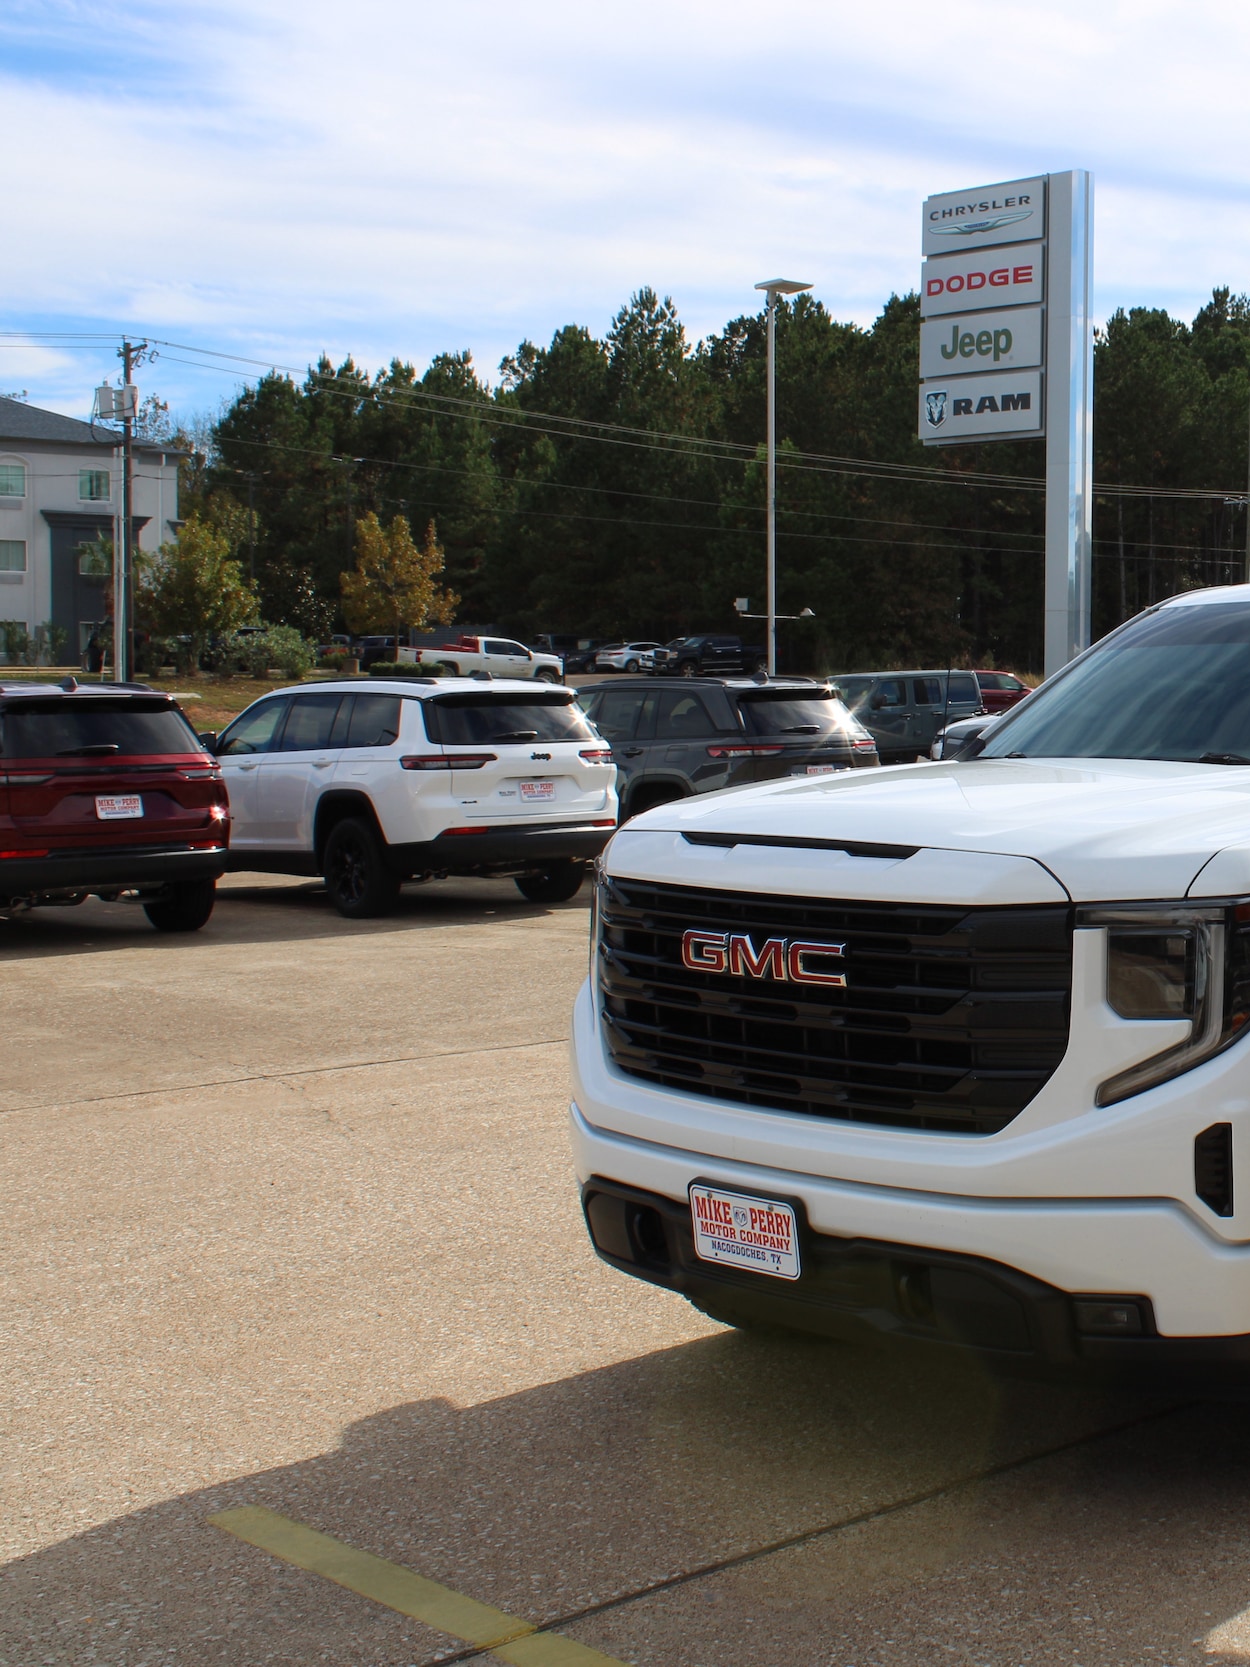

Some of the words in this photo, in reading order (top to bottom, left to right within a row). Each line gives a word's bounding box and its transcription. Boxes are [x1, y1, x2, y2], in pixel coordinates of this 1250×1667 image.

[929, 195, 1031, 221] CHRYSLER
[926, 265, 1033, 297] DODGE
[940, 325, 1013, 362] Jeep
[953, 392, 1031, 416] RAM
[98, 799, 115, 807] MIKE
[682, 929, 847, 987] GMC
[695, 1195, 733, 1225] MIKE
[749, 1207, 791, 1238] PERRY
[700, 1220, 737, 1240] MOTOR
[739, 1229, 790, 1252] COMPANY
[770, 1253, 782, 1265] TX
